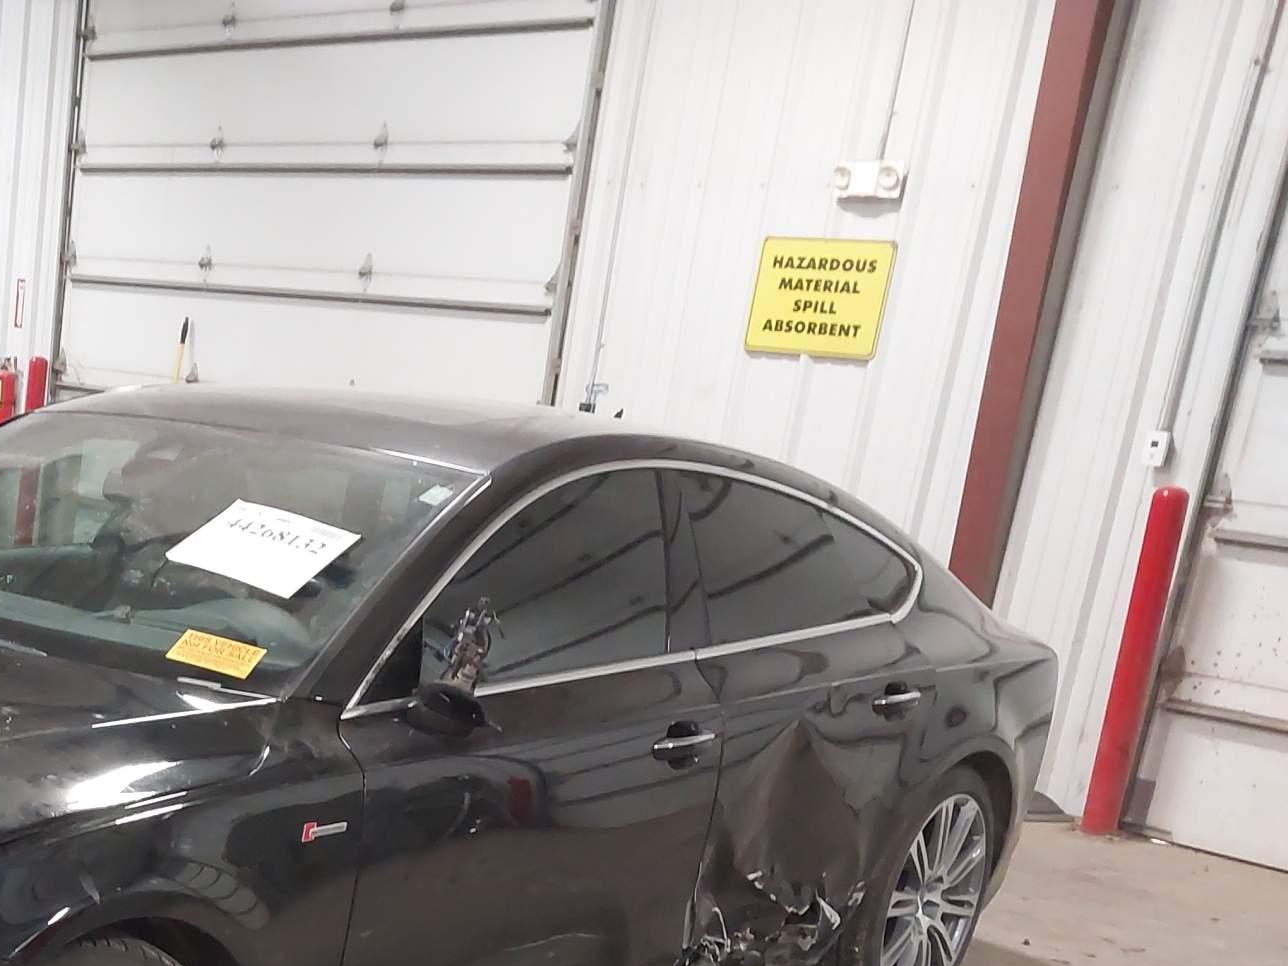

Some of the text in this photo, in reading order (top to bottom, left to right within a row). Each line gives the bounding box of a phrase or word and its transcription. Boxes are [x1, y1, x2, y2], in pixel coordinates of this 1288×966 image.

[772, 255, 877, 273] HAZARDOUS
[778, 277, 860, 294] MATERIAL
[792, 299, 837, 315] SPILL
[762, 319, 861, 338] ABSORBENT
